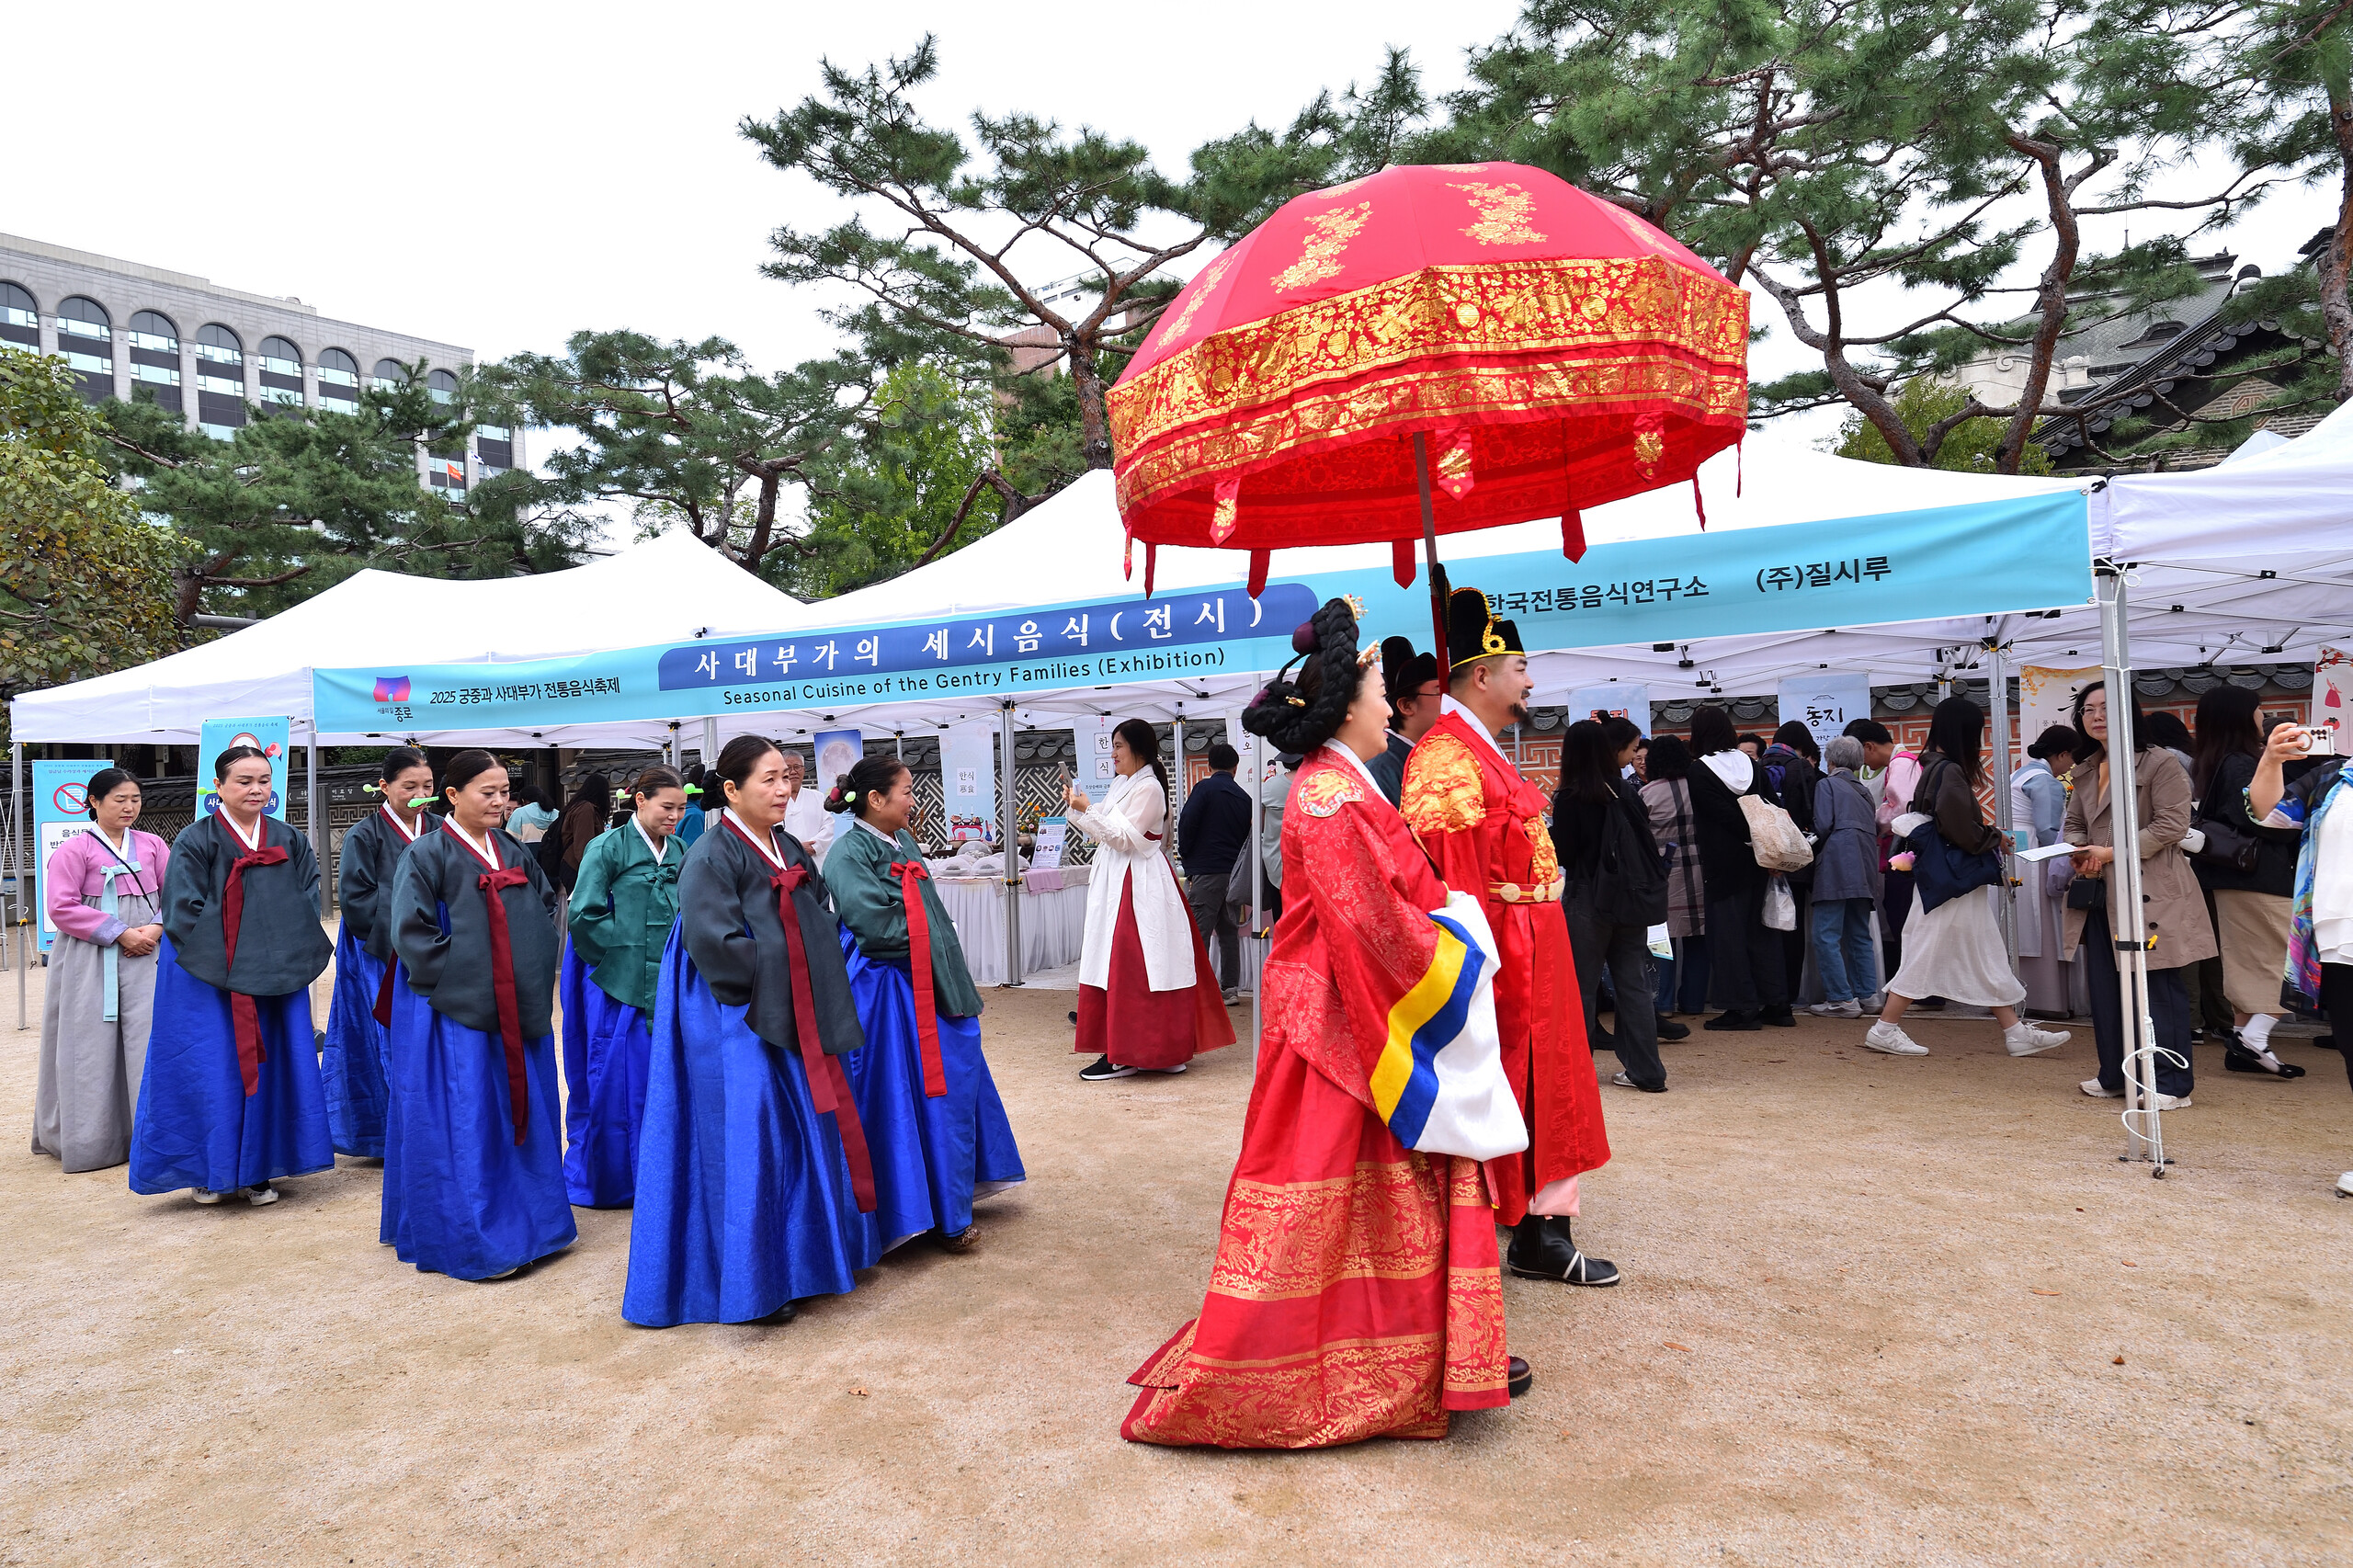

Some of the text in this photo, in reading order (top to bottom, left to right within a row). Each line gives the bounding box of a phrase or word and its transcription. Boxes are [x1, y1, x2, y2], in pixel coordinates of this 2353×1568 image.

[1756, 555, 1892, 593] (주)질시루
[694, 635, 879, 680] 사대부가의
[429, 676, 621, 704] 2025 궁중과 사대부가 전통음식축제
[723, 647, 1225, 705] Seasonal Cuisine of the Gentry Families (Exhibition)
[394, 707, 414, 722] 종로
[1806, 706, 1844, 727] 동지
[959, 771, 975, 781] 한식
